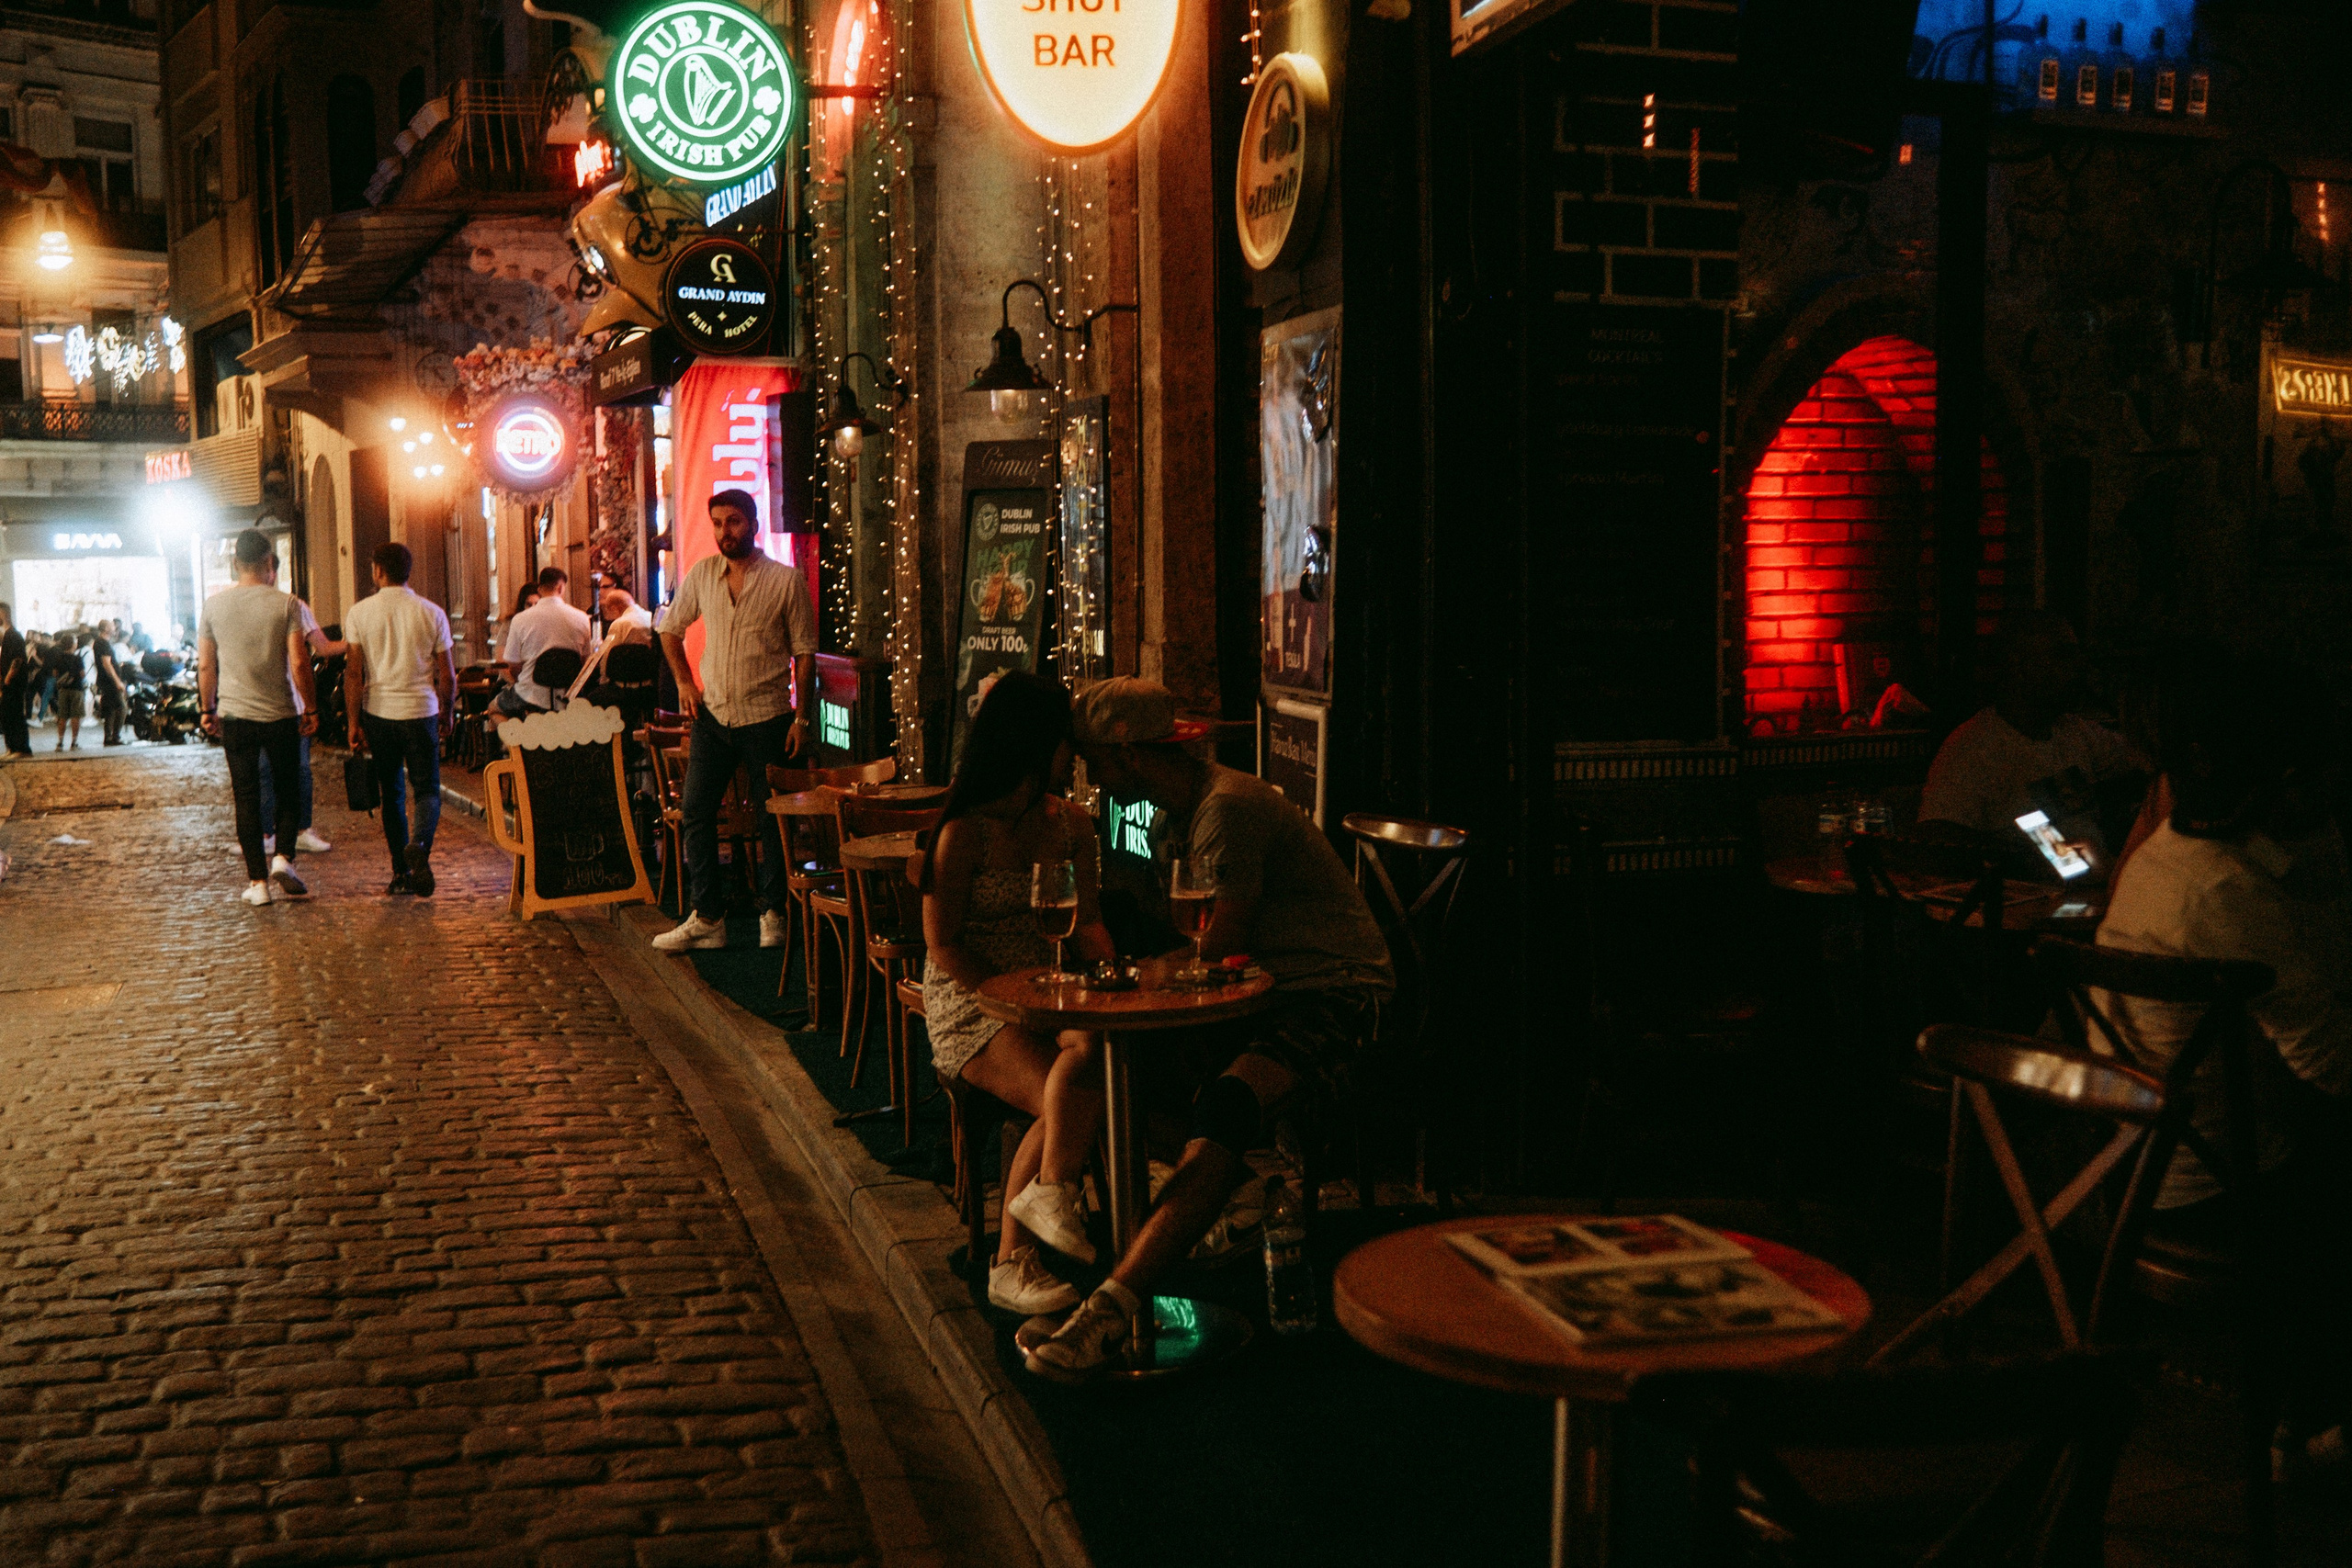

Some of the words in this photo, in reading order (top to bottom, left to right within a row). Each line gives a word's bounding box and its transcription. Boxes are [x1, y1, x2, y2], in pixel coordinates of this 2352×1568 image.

[628, 14, 776, 88] DUBLIN
[1034, 34, 1115, 66] BAR
[645, 119, 725, 166] IRISH
[724, 115, 772, 162] PUB
[678, 286, 726, 301] GRAND
[726, 289, 766, 306] AYDIN
[724, 315, 758, 339] HOTEL
[145, 450, 192, 485] KOSKA
[1001, 508, 1033, 520] DUBLIN
[1000, 523, 1023, 534] IRISH
[1023, 523, 1041, 534] PUB
[967, 636, 999, 651] ONLY
[1125, 823, 1151, 859] IRIS
